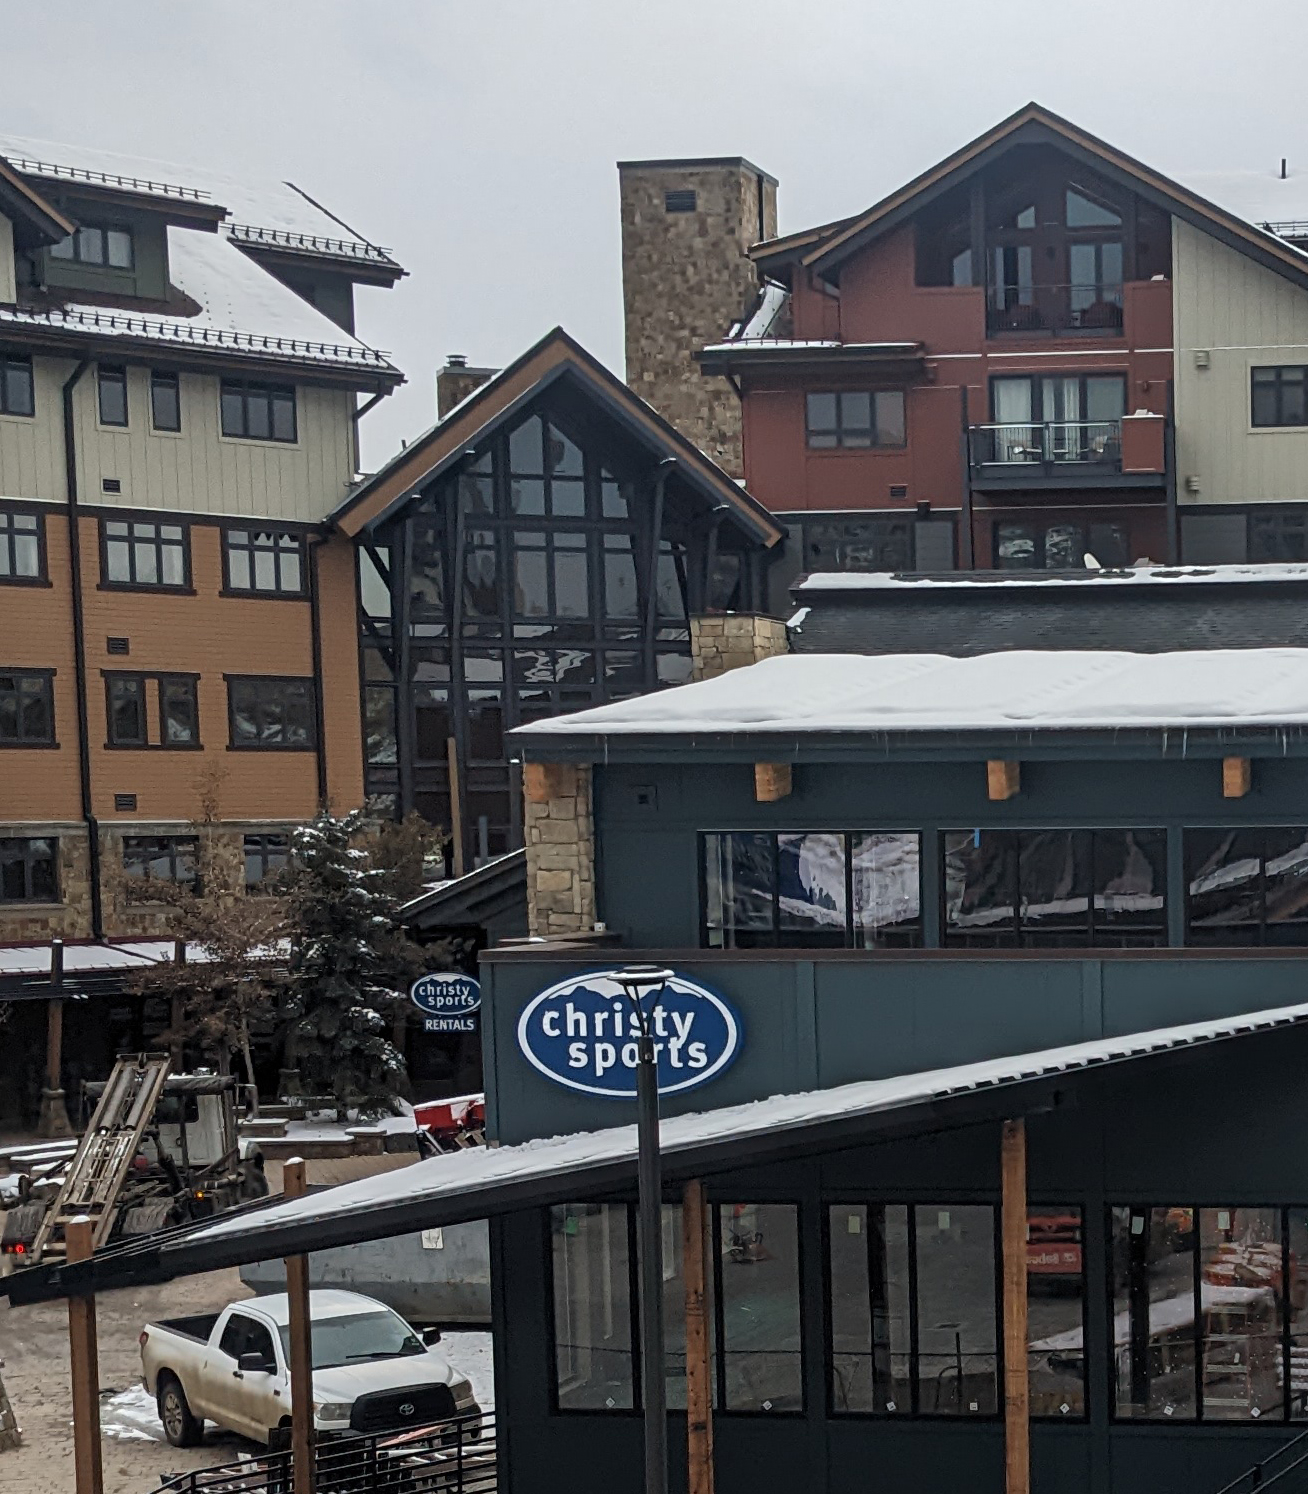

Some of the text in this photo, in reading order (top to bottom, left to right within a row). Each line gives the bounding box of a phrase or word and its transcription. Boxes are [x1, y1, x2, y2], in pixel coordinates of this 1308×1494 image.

[419, 983, 470, 999] christy
[428, 994, 474, 1007] sports
[426, 1019, 474, 1031] RENTALS
[542, 1002, 695, 1045] christy
